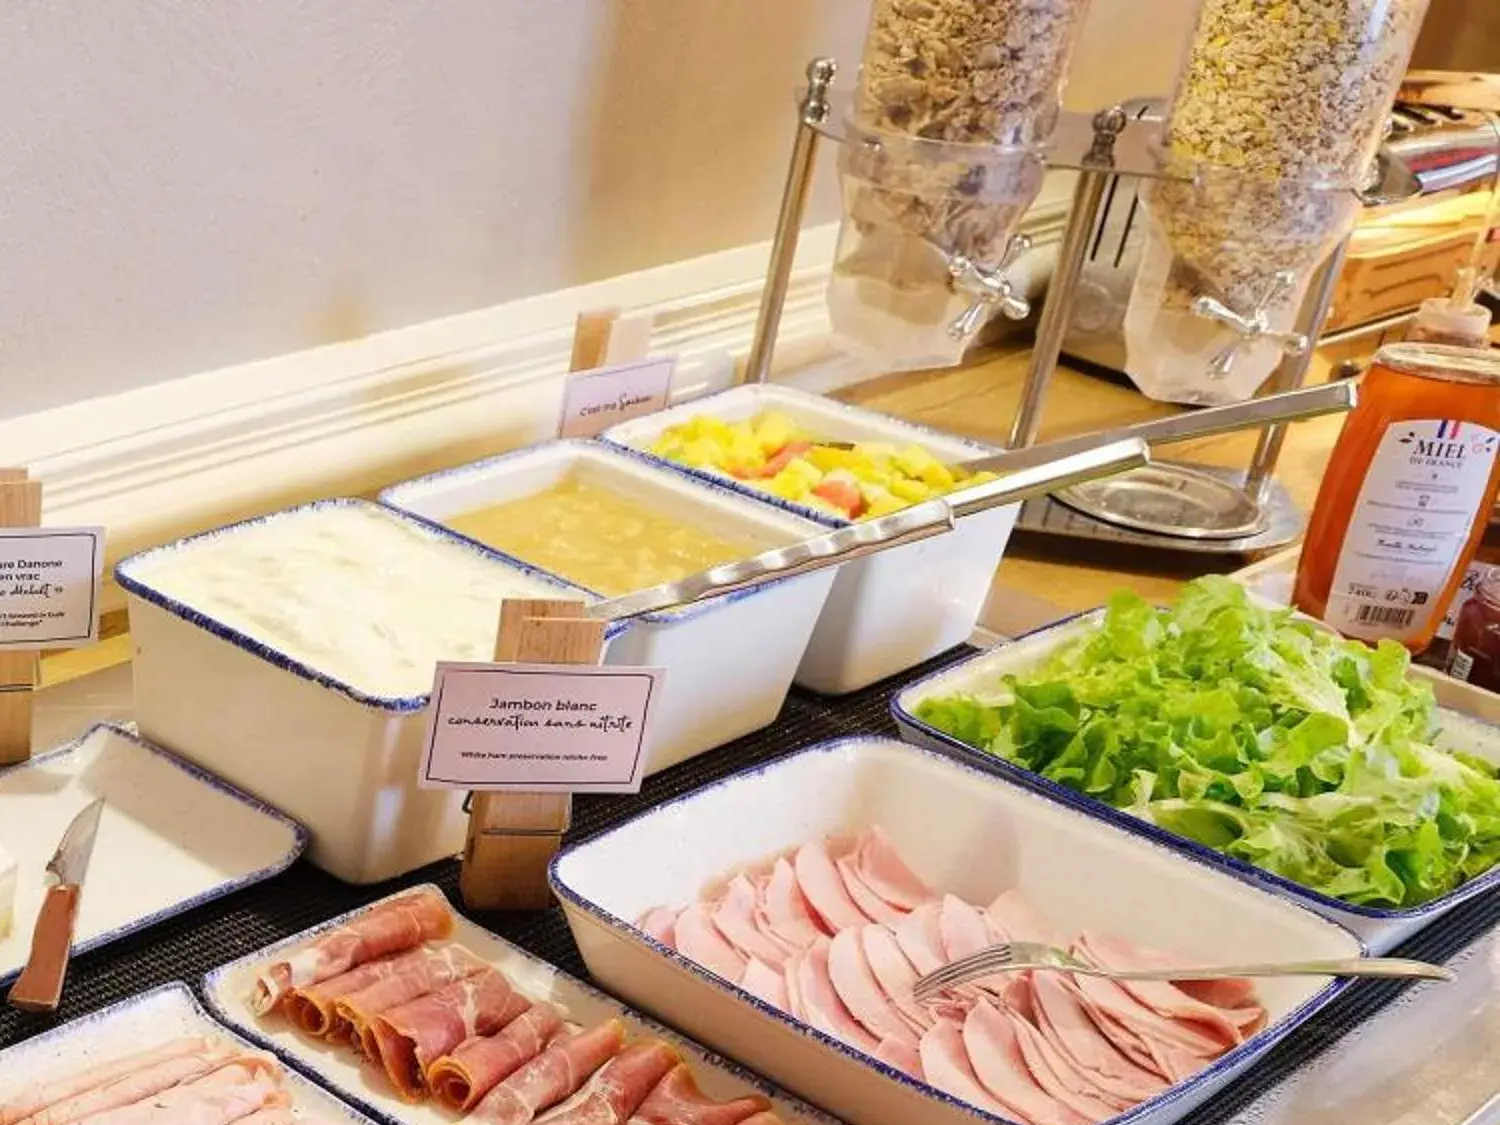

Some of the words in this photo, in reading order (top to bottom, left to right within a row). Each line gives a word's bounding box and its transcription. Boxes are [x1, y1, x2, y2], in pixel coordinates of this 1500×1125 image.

[1413, 440, 1467, 459] MIEL
[17, 559, 62, 569] Danone
[15, 572, 40, 581] vrac
[489, 698, 551, 712] Jambon
[555, 699, 597, 712] blanc
[447, 714, 539, 731] conservation
